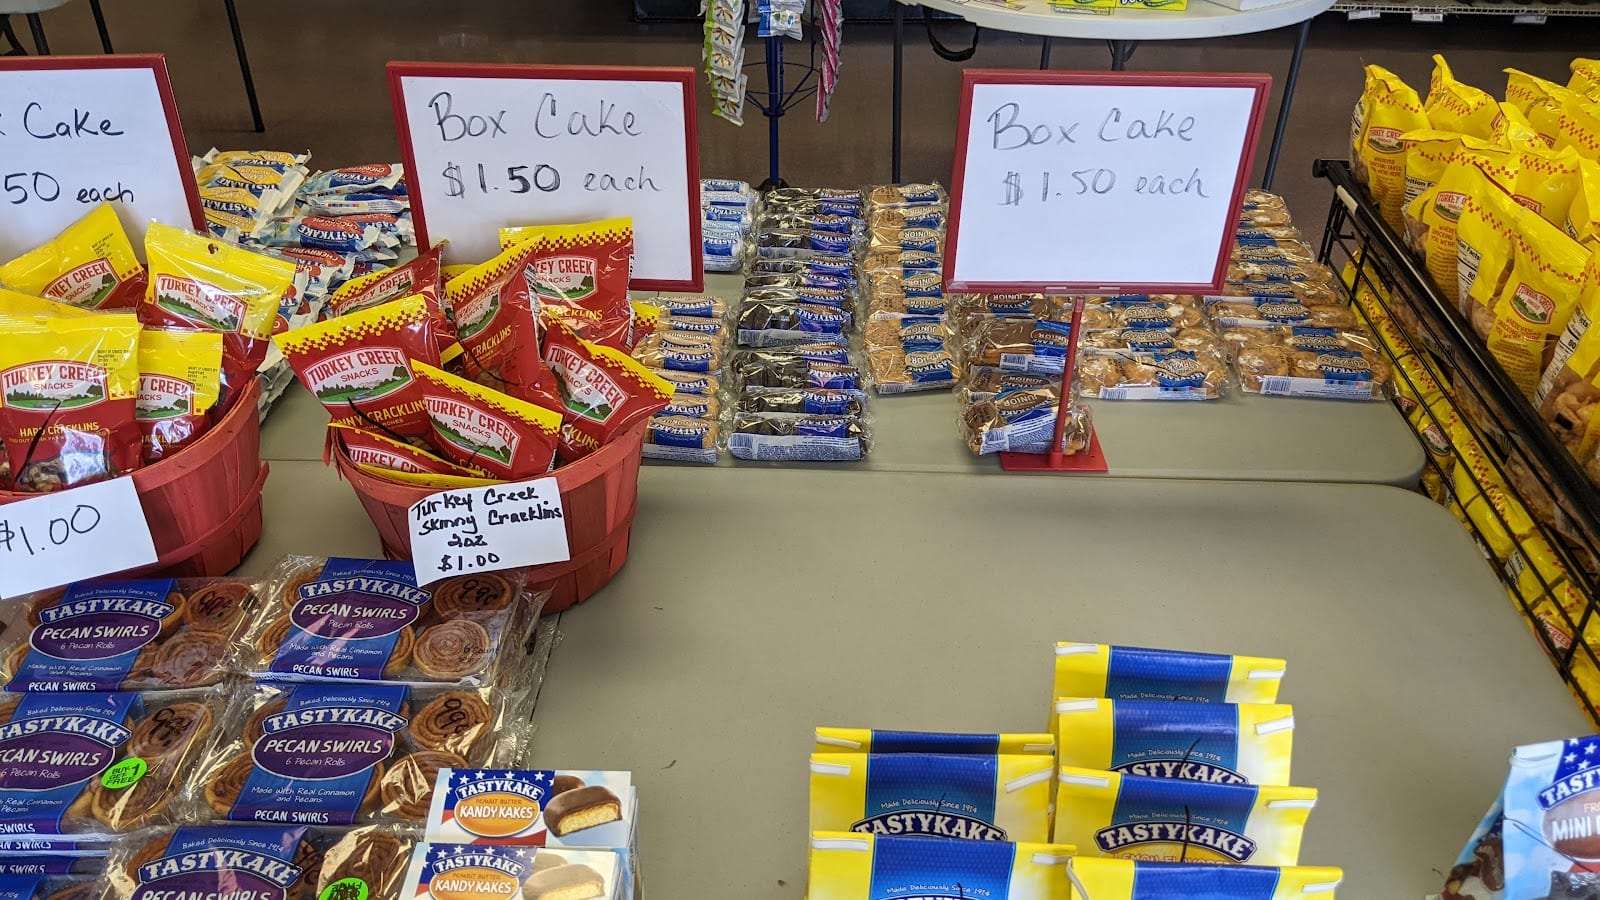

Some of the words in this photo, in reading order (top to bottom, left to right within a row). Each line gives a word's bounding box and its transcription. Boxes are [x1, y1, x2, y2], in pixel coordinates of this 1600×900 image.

[23, 101, 124, 139] Cake
[428, 91, 509, 142] Box
[535, 92, 643, 138] Cake
[987, 102, 1079, 150] Box
[1098, 107, 1195, 142] Cake
[441, 161, 561, 199] $1.50
[584, 165, 662, 193] each
[1136, 168, 1210, 198] each
[76, 181, 134, 204] each
[298, 224, 361, 241] TASTYKAKE
[904, 230, 932, 239] JUNIOR
[309, 249, 339, 262] CHERRY
[1466, 246, 1482, 261] Facts
[72, 262, 110, 284] CREEK
[558, 259, 593, 275] CREEK
[161, 278, 202, 299] TURKEY
[379, 270, 411, 293] CREEK
[184, 294, 215, 313] SNACKS
[666, 299, 715, 309] TASTYKAKE
[987, 299, 1031, 309] TASTYKAKE
[796, 308, 843, 321] TASTYKAKE
[670, 320, 720, 330] TASTYKAKE
[906, 325, 937, 335] JUNIOR
[471, 325, 512, 358] CRACKLINS
[1038, 332, 1068, 343] JUNIOR
[659, 348, 713, 361] TASTYKAKE
[308, 355, 354, 385] TURKEY
[356, 350, 404, 366] CREEK
[340, 367, 379, 383] SNACKS
[807, 369, 858, 378] TASTYKAKE
[3, 364, 57, 389] TURKEY
[59, 365, 101, 385] CREEK
[550, 346, 584, 375] TURKEY
[584, 362, 625, 412] CREEK
[1009, 376, 1043, 384] JUNIOR
[33, 381, 74, 391] SNACKS
[150, 378, 189, 400] CREEK
[800, 391, 852, 403] TASTYKAKE
[1003, 394, 1038, 406] JUNIOR
[366, 399, 427, 423] CRACKLINS
[47, 421, 100, 436] CRACKLINS
[426, 399, 475, 422] TURKEY
[478, 413, 516, 450] CREEK
[452, 419, 491, 439] SNACKS
[651, 423, 709, 436] TASTYKAKE
[411, 493, 473, 520] Turkey
[484, 487, 539, 506] Creek
[488, 500, 563, 526] Cracklins
[0, 504, 100, 556] $1.00
[438, 552, 501, 572] $1.00
[303, 578, 428, 603] TASTYKAKE
[45, 599, 170, 621] TASTYKAKE
[300, 603, 352, 618] PECAN
[352, 606, 408, 619] SWIRLS
[355, 620, 375, 629] Rolls
[40, 627, 92, 640] PECAN
[93, 625, 150, 638] SWIRLS
[327, 651, 354, 659] Pecans
[349, 647, 383, 655] Cinnamon
[293, 664, 323, 675] PECAN
[327, 666, 359, 677] SWIRLS
[28, 681, 60, 691] PECAN
[62, 681, 96, 691] SWIRLS
[322, 695, 357, 704] Deliciously
[1140, 692, 1175, 700] Deliciously
[268, 708, 402, 730] TASTYKAKE
[0, 716, 127, 744] TASTYKAKE
[263, 739, 321, 753] PECAN
[321, 740, 382, 754] SWIRLS
[0, 748, 40, 763] ECAN
[38, 750, 102, 766] SWIRLS
[295, 757, 322, 766] Pecan
[324, 757, 346, 766] Rolls
[1205, 752, 1221, 761] 1914
[10, 768, 38, 777] Pecan
[40, 770, 61, 778] Rolls
[105, 776, 135, 785] FREE
[1116, 761, 1244, 785] ASTYKAKE
[252, 786, 273, 794] Made
[276, 787, 294, 795] with
[297, 788, 315, 796] Real
[318, 788, 356, 796] Cinnamon
[458, 779, 542, 800] TASTYKAKE
[5, 798, 26, 806] Real
[881, 801, 899, 809] Made
[901, 799, 939, 808] Deliciously
[940, 800, 960, 809] Since
[962, 804, 978, 813] 1914
[254, 809, 288, 821] PECAN
[292, 811, 329, 823] SWIRLS
[459, 805, 498, 819] KANDY
[498, 806, 534, 819] KAKES
[0, 823, 36, 833] SWIRLS
[854, 813, 1002, 840] TASTYKAKE
[1552, 815, 1591, 842] MINI
[15, 841, 52, 850] SWIRLS
[182, 839, 205, 849] Baked
[208, 837, 247, 846] Deliciously
[248, 839, 266, 849] Since
[1101, 823, 1251, 858] TASTYKAKE
[9, 864, 46, 874] SWIRLS
[145, 849, 297, 884] TASTYKAKE
[435, 856, 522, 875] TASTYKAKE
[435, 879, 475, 892] KANDY
[476, 880, 512, 893] KAKES
[887, 886, 907, 894] Made
[910, 884, 949, 892] Deliciously
[973, 888, 990, 896] 1914
